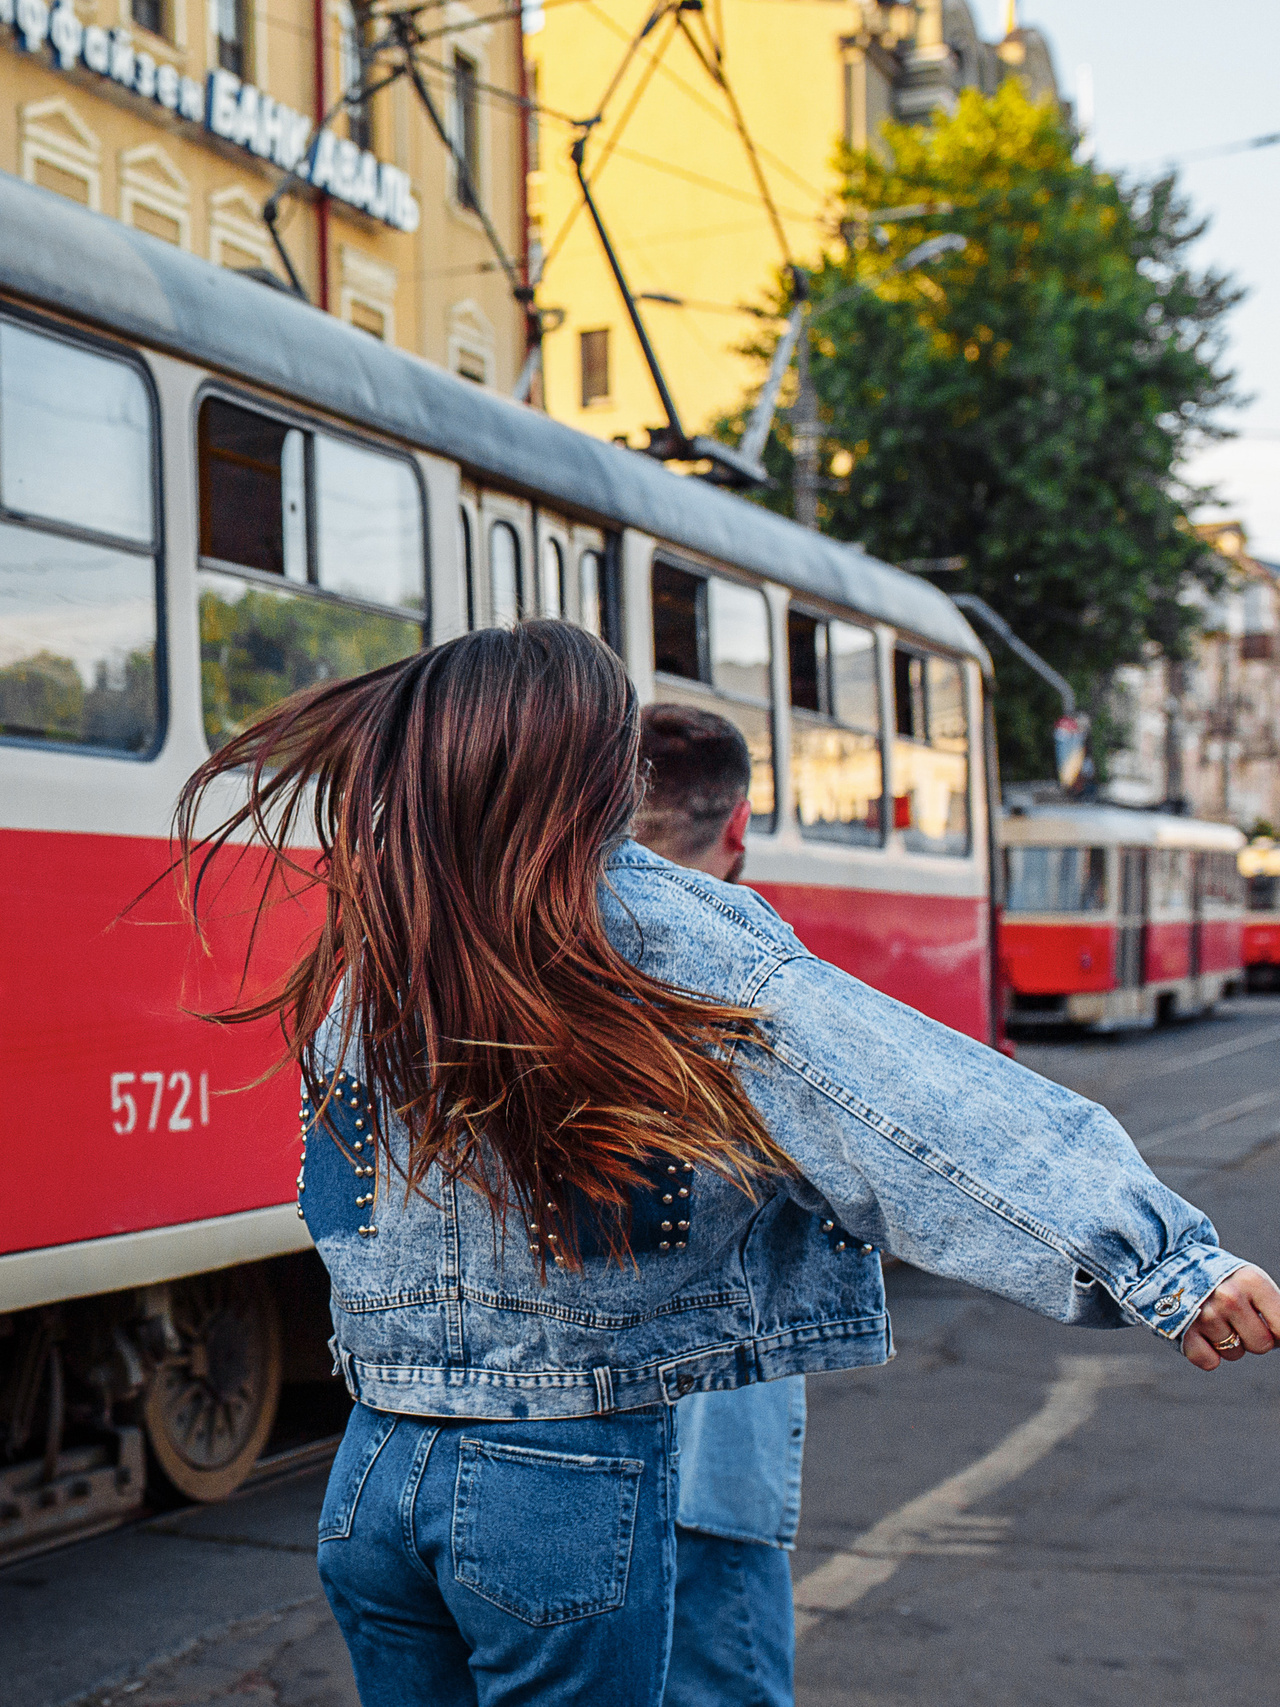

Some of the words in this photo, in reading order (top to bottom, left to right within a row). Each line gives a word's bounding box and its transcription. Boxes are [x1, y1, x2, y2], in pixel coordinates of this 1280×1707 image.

[208, 69, 312, 178] БАНК
[310, 129, 420, 233] АВАЛЬ
[111, 1071, 209, 1134] 5721
